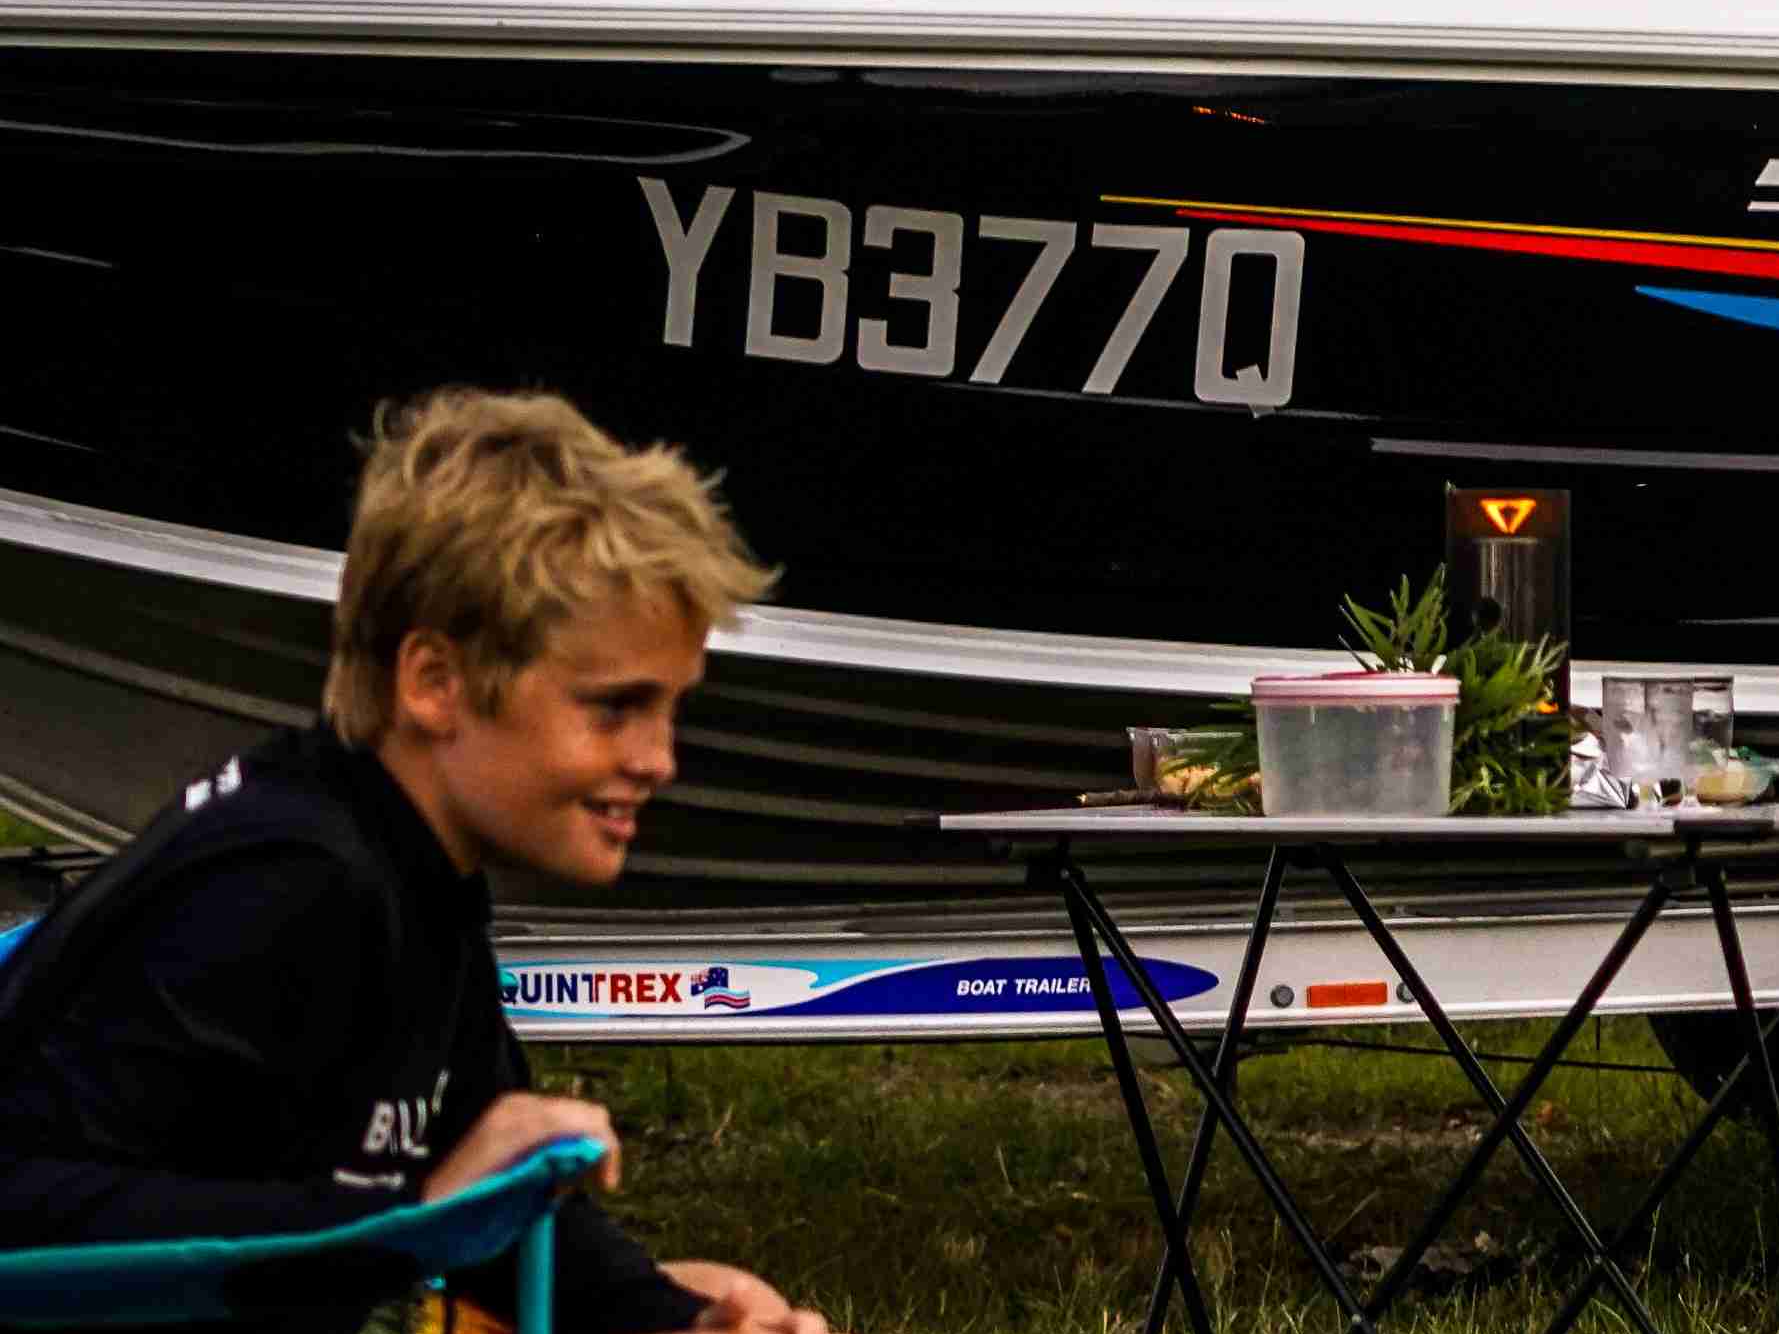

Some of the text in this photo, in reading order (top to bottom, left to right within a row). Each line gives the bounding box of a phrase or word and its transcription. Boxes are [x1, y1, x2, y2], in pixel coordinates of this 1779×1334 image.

[637, 176, 1305, 418] YB377Q
[956, 976, 1092, 996] BOAT TRAILER
